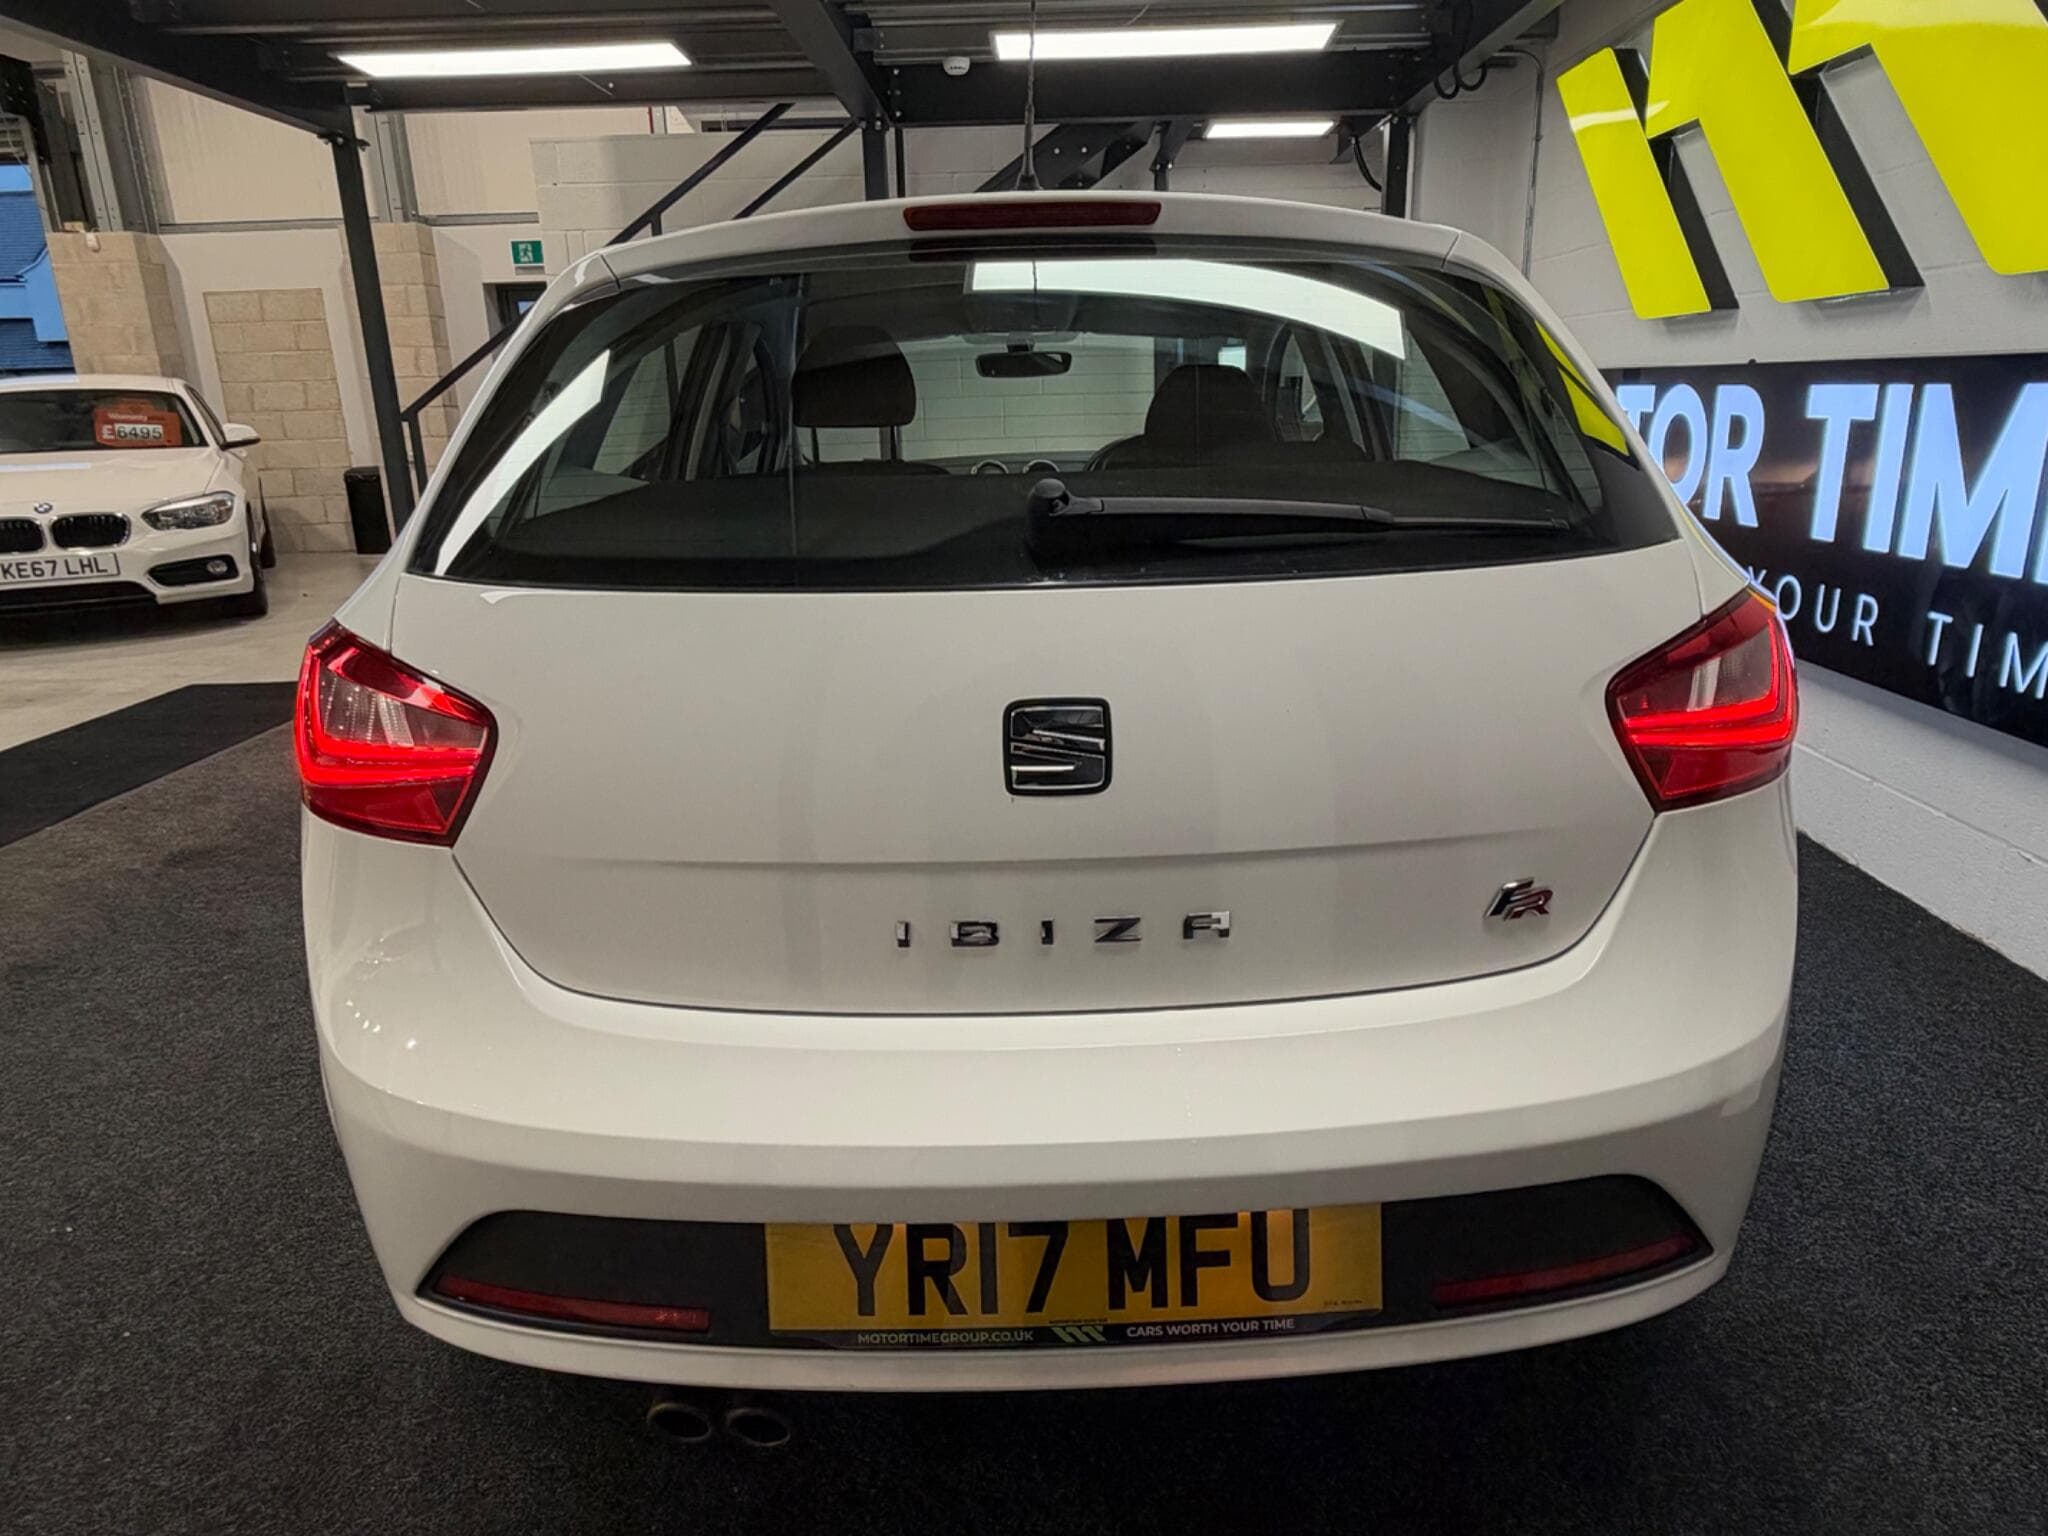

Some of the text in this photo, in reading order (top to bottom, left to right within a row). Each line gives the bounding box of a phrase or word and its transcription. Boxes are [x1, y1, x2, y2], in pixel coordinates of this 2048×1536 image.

[0, 556, 109, 580] KE67 LHL
[896, 910, 1231, 948] IBIZA
[833, 1208, 1311, 1317] YR17 MFU
[857, 1330, 1034, 1345] MOTORTIMEGROUP.CO.UK
[1126, 1318, 1296, 1338] CARS WORTH YOUR TIME
